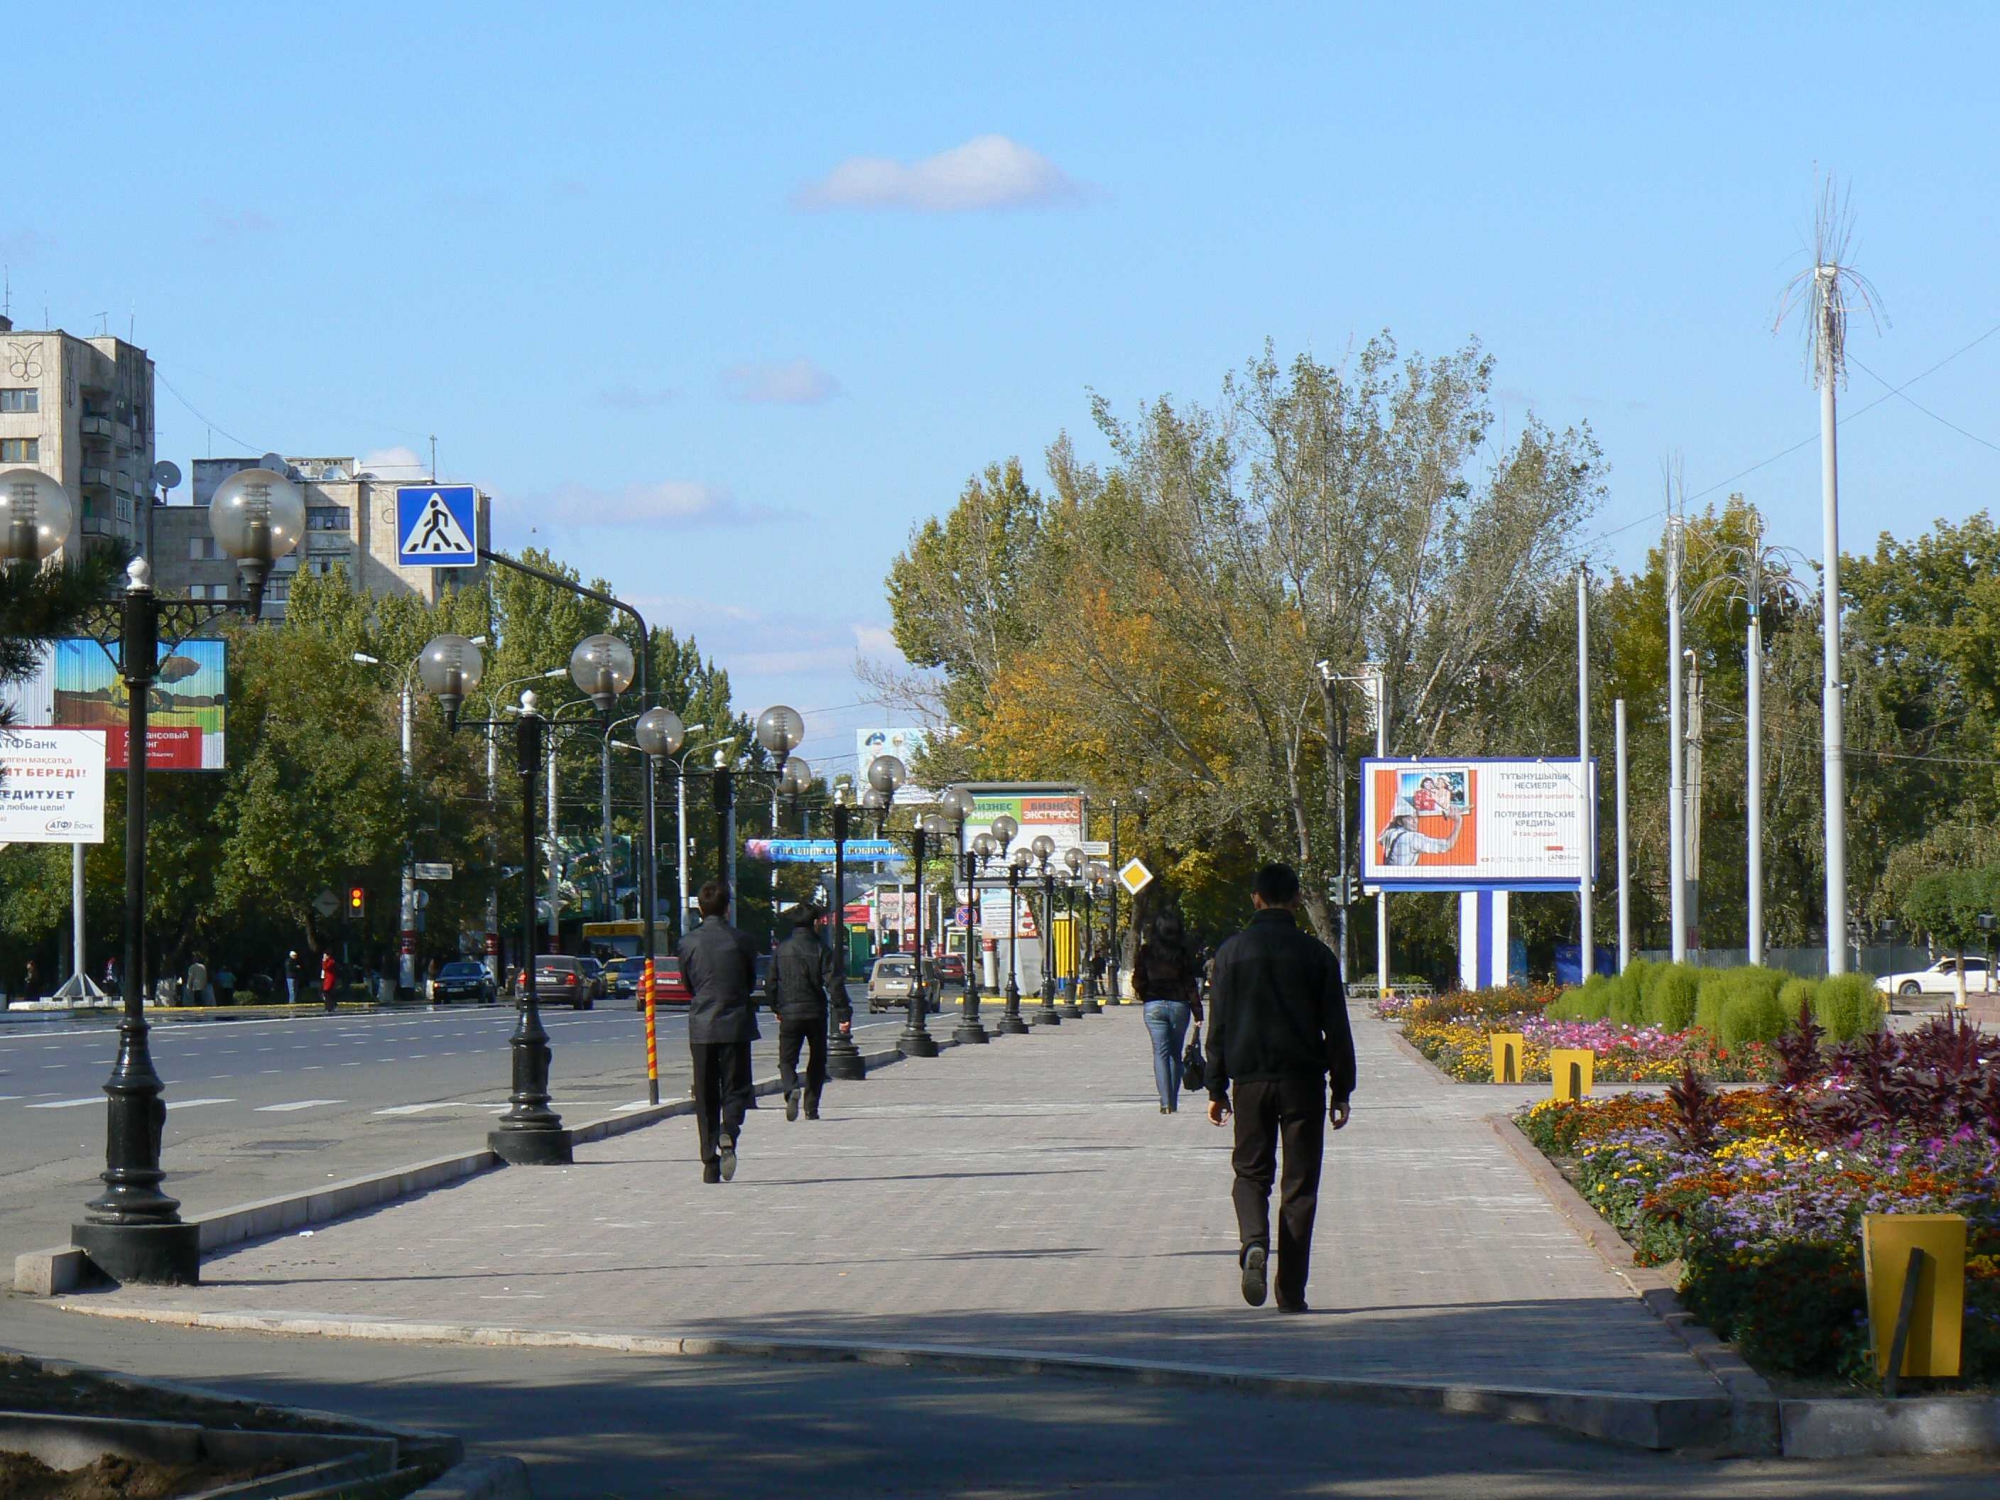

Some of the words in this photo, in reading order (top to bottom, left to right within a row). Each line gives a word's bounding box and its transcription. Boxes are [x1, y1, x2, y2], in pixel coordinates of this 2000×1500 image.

[7, 803, 39, 811] любые
[40, 804, 65, 812] цели!
[1031, 802, 1073, 811] БИЗНЕС
[1023, 811, 1079, 820] ЭКСПРЕСС
[1494, 810, 1576, 818] ПОТРЕБИТЕЛЬСКИЕ
[74, 821, 94, 829] Банк
[1515, 820, 1556, 828] КРЕДИТЫ
